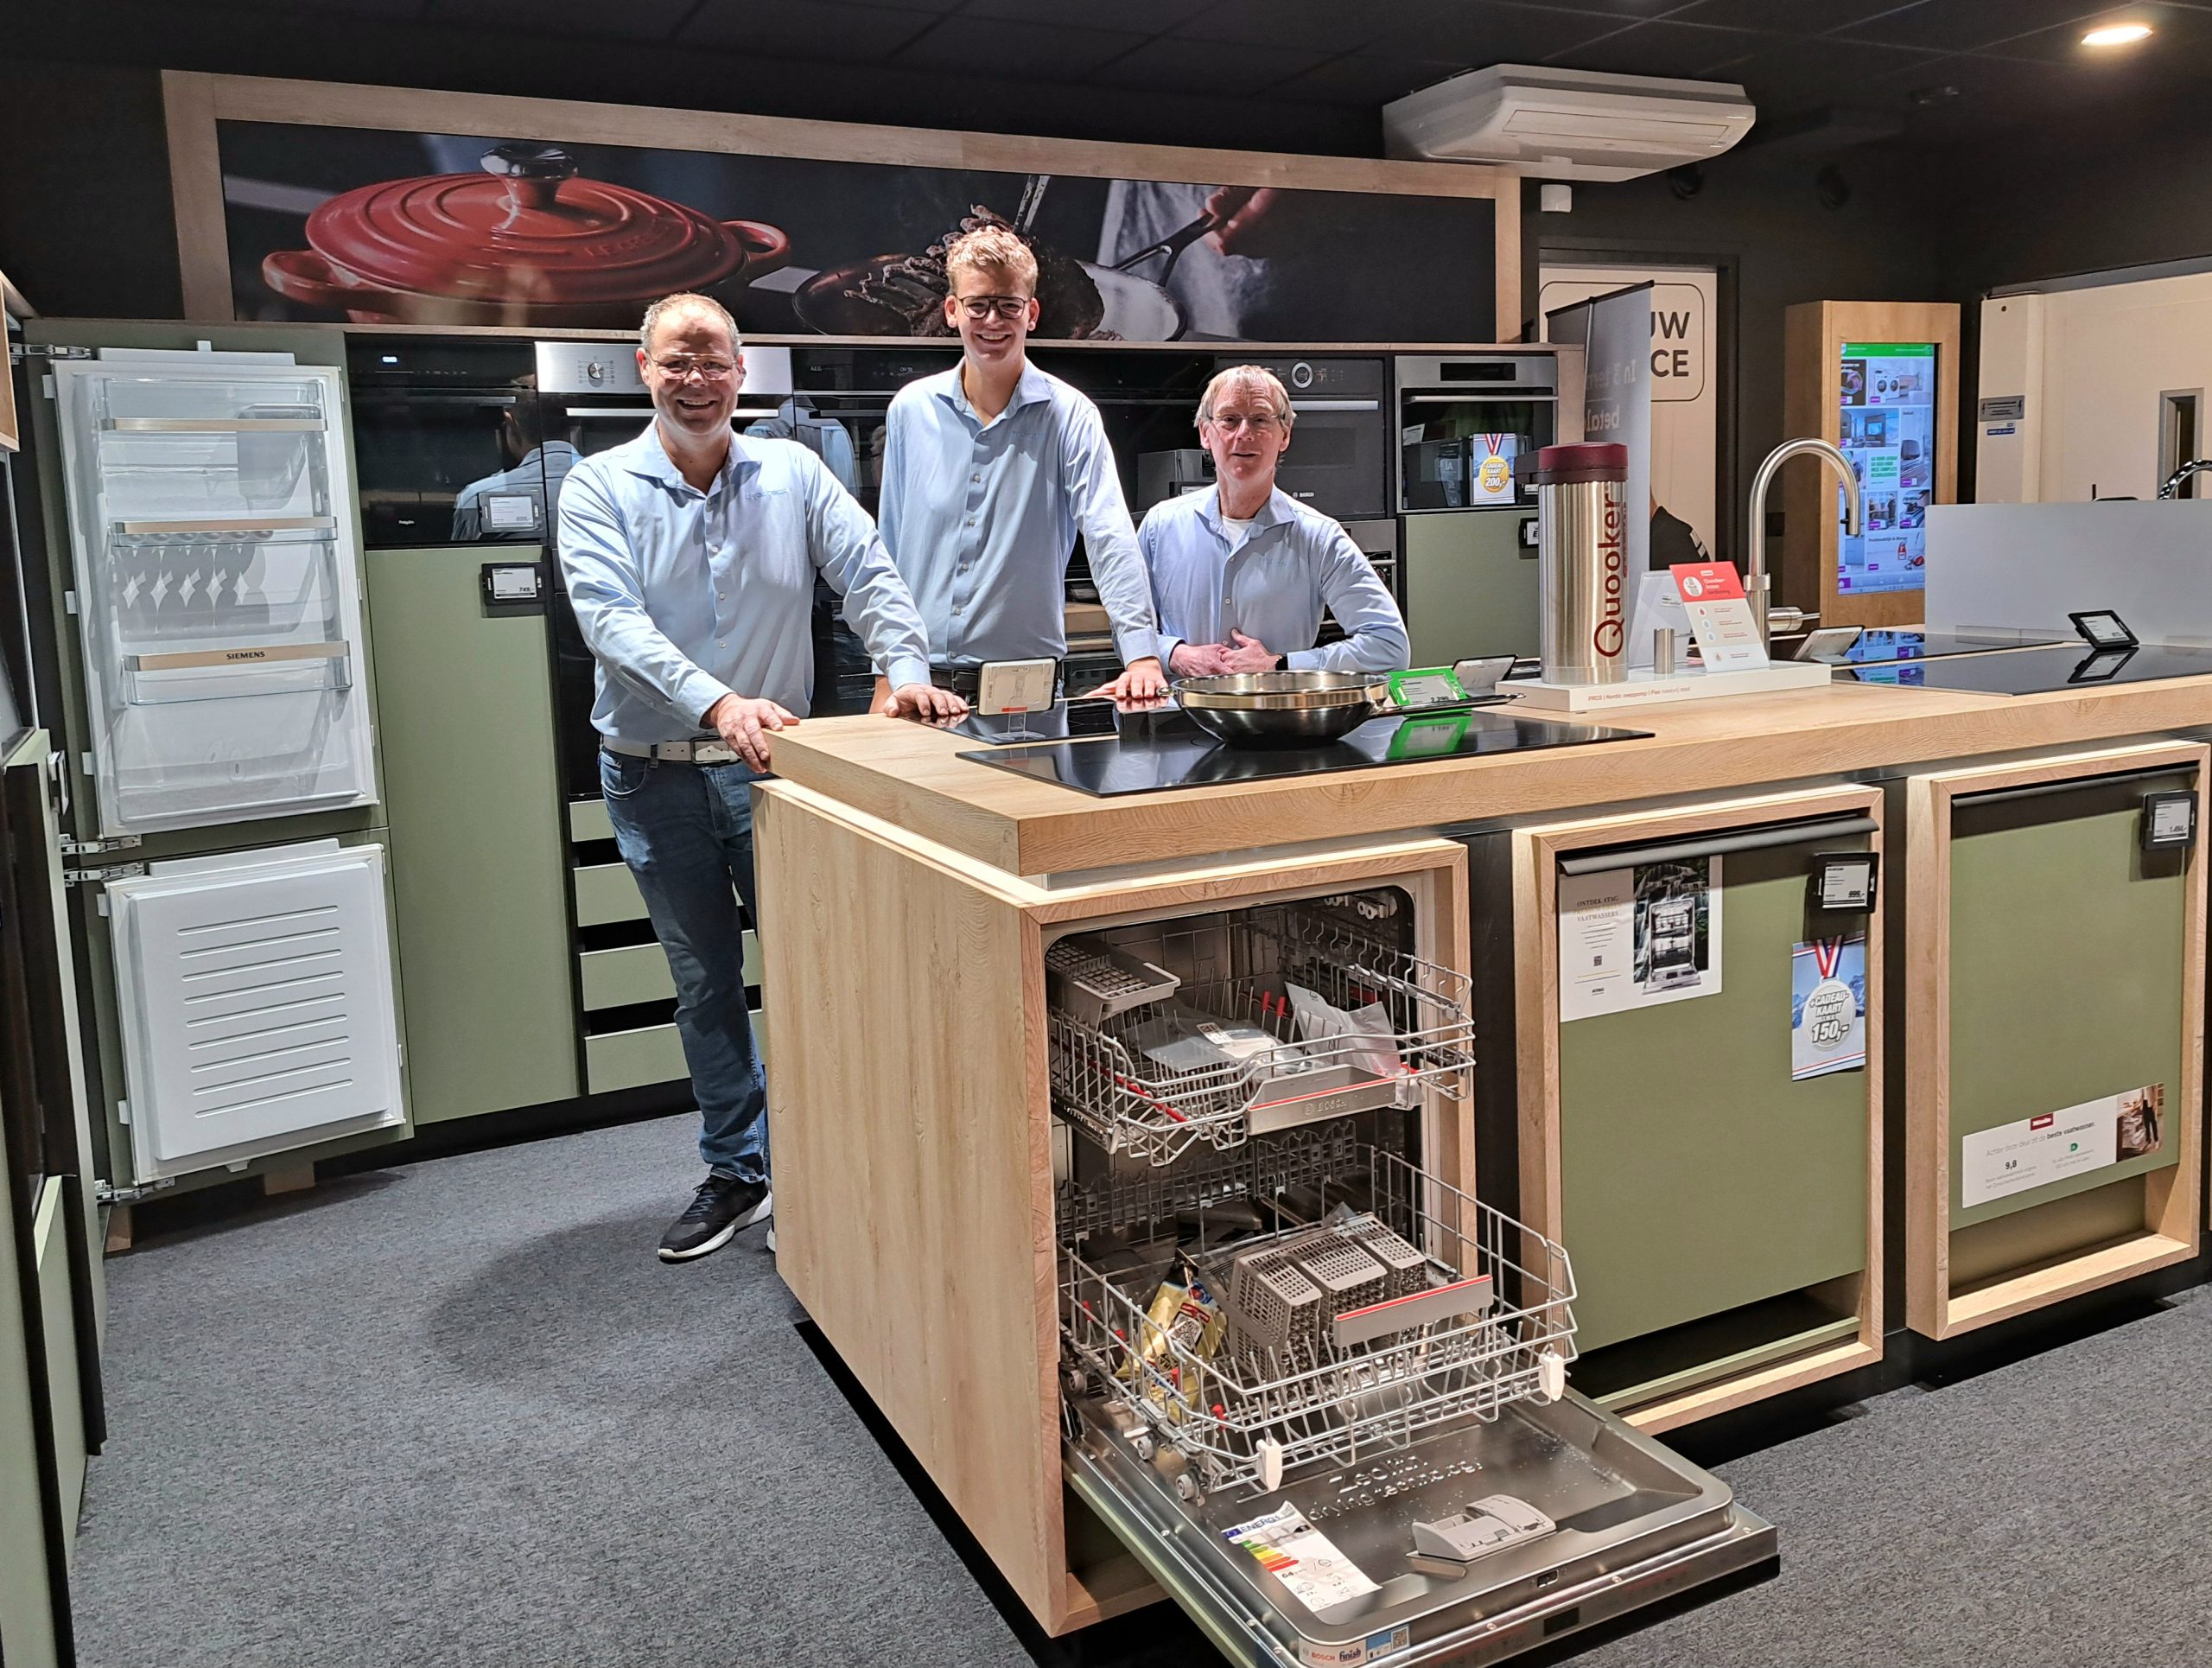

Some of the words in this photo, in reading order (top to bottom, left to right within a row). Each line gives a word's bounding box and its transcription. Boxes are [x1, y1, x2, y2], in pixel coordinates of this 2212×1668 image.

[1593, 493, 1625, 658] Quooker
[226, 651, 266, 660] SIEMENS
[1577, 898, 1601, 908] ONTDEK
[1815, 1002, 1844, 1018] KAART
[1811, 1019, 1851, 1044] 150,-
[2046, 1130, 2063, 1141] beste
[2005, 1159, 2018, 1171] 9,8
[1307, 1493, 1376, 1521] drying
[1310, 1652, 1336, 1662] BOSCH
[1339, 1646, 1362, 1662] finish
